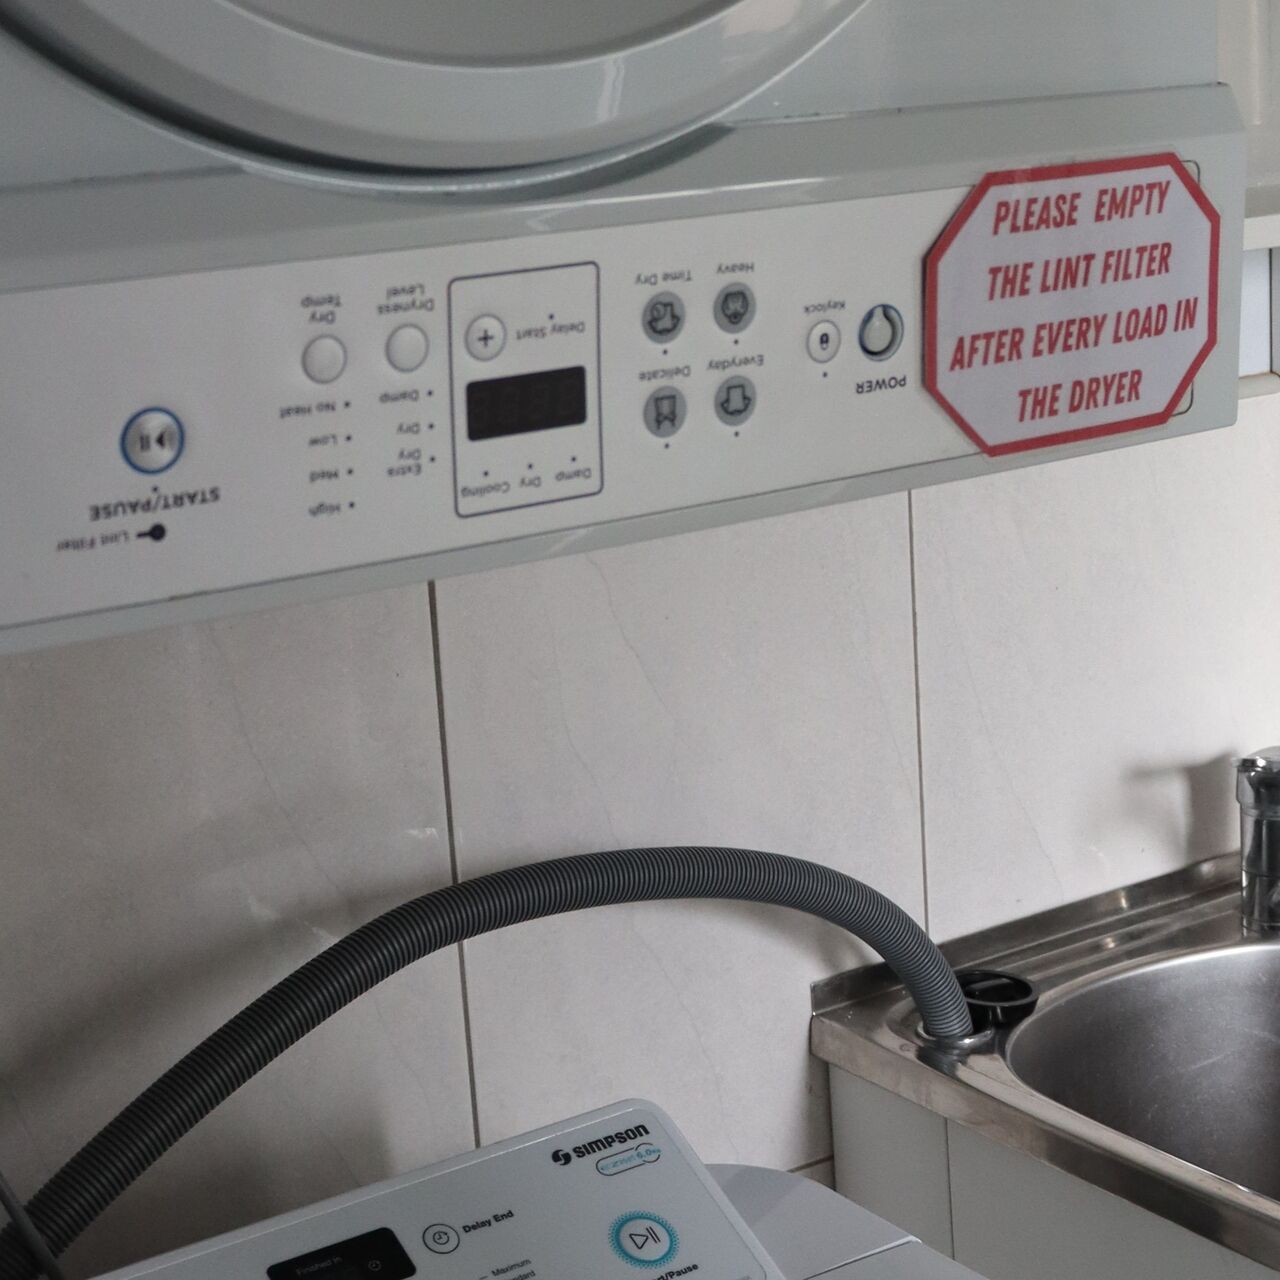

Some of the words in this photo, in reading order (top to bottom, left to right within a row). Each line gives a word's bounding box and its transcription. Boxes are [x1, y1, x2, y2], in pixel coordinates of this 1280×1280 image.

[992, 192, 1080, 234] PLEASE
[1094, 180, 1171, 222] EMPTY
[662, 269, 693, 285] Time
[716, 259, 755, 277] Heavy
[987, 262, 1034, 301] THE
[1041, 254, 1094, 293] LINT
[1101, 241, 1172, 285] FILTER
[634, 271, 658, 289] Dry
[301, 293, 341, 309] Temp
[386, 284, 424, 301] Level
[376, 296, 435, 316] Dryness
[803, 299, 846, 317] Keylock
[308, 308, 336, 325] Dry
[516, 324, 547, 342] Start
[550, 319, 585, 338] Delay
[949, 328, 1024, 371] AFTER
[1032, 315, 1106, 357] EVERY
[1113, 306, 1168, 344] LOAD
[1173, 297, 1198, 333] IN
[706, 353, 764, 373] Everyday
[638, 365, 692, 383] Delicate
[855, 375, 906, 394] POWER
[379, 388, 419, 406] Damp
[1018, 384, 1063, 422] THE
[1069, 369, 1143, 413] DRYER
[279, 403, 313, 420] Heat
[316, 401, 336, 415] No
[396, 420, 421, 437] Dry
[308, 434, 336, 449] Low
[397, 447, 421, 463] Dry
[309, 469, 339, 483] Med
[387, 463, 421, 479] Extra
[555, 467, 592, 485] Damp
[460, 480, 511, 501] Cooling
[519, 475, 542, 491] Dry
[89, 486, 220, 520] START/PAUSE
[308, 500, 341, 518] High
[56, 534, 96, 553] Filter
[101, 529, 130, 547] Lint
[574, 1125, 650, 1159] SIMPSON
[463, 1219, 492, 1234] Delay
[493, 1210, 514, 1223] End
[491, 1258, 531, 1277] Maximum
